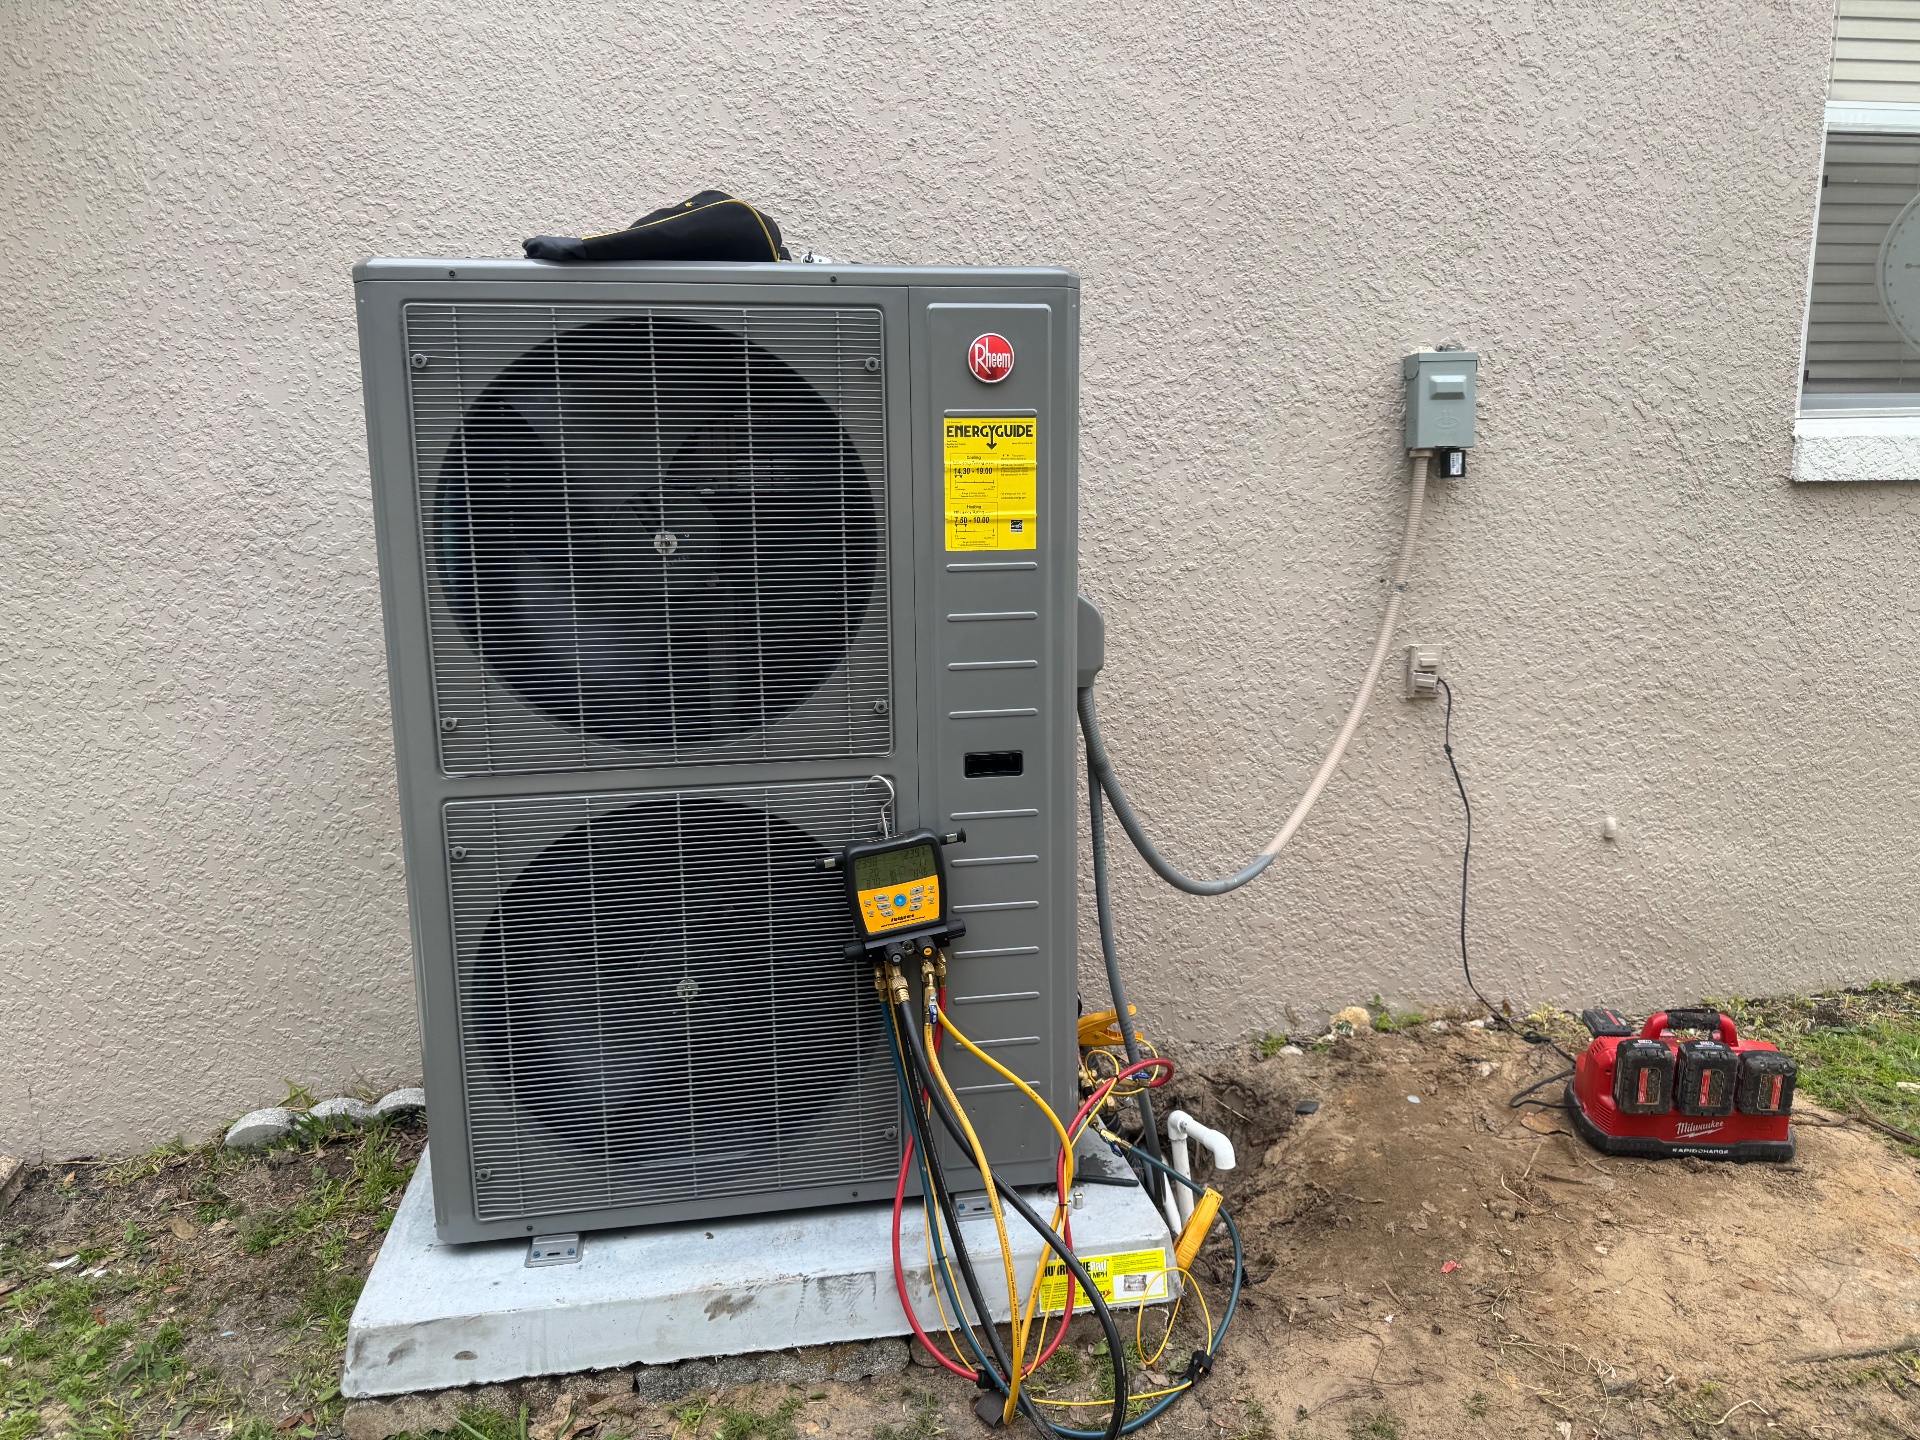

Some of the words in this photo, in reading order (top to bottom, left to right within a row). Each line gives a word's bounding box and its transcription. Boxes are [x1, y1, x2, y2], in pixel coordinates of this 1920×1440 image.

[974, 337, 1011, 375] Rheem
[946, 424, 1034, 438] ENERGYGUIDE
[954, 467, 971, 475] 14.30
[976, 467, 993, 475] 19.00
[973, 516, 990, 524] 10.00
[1675, 1119, 1725, 1135] Milwaukee
[1092, 1270, 1108, 1279] MPH
